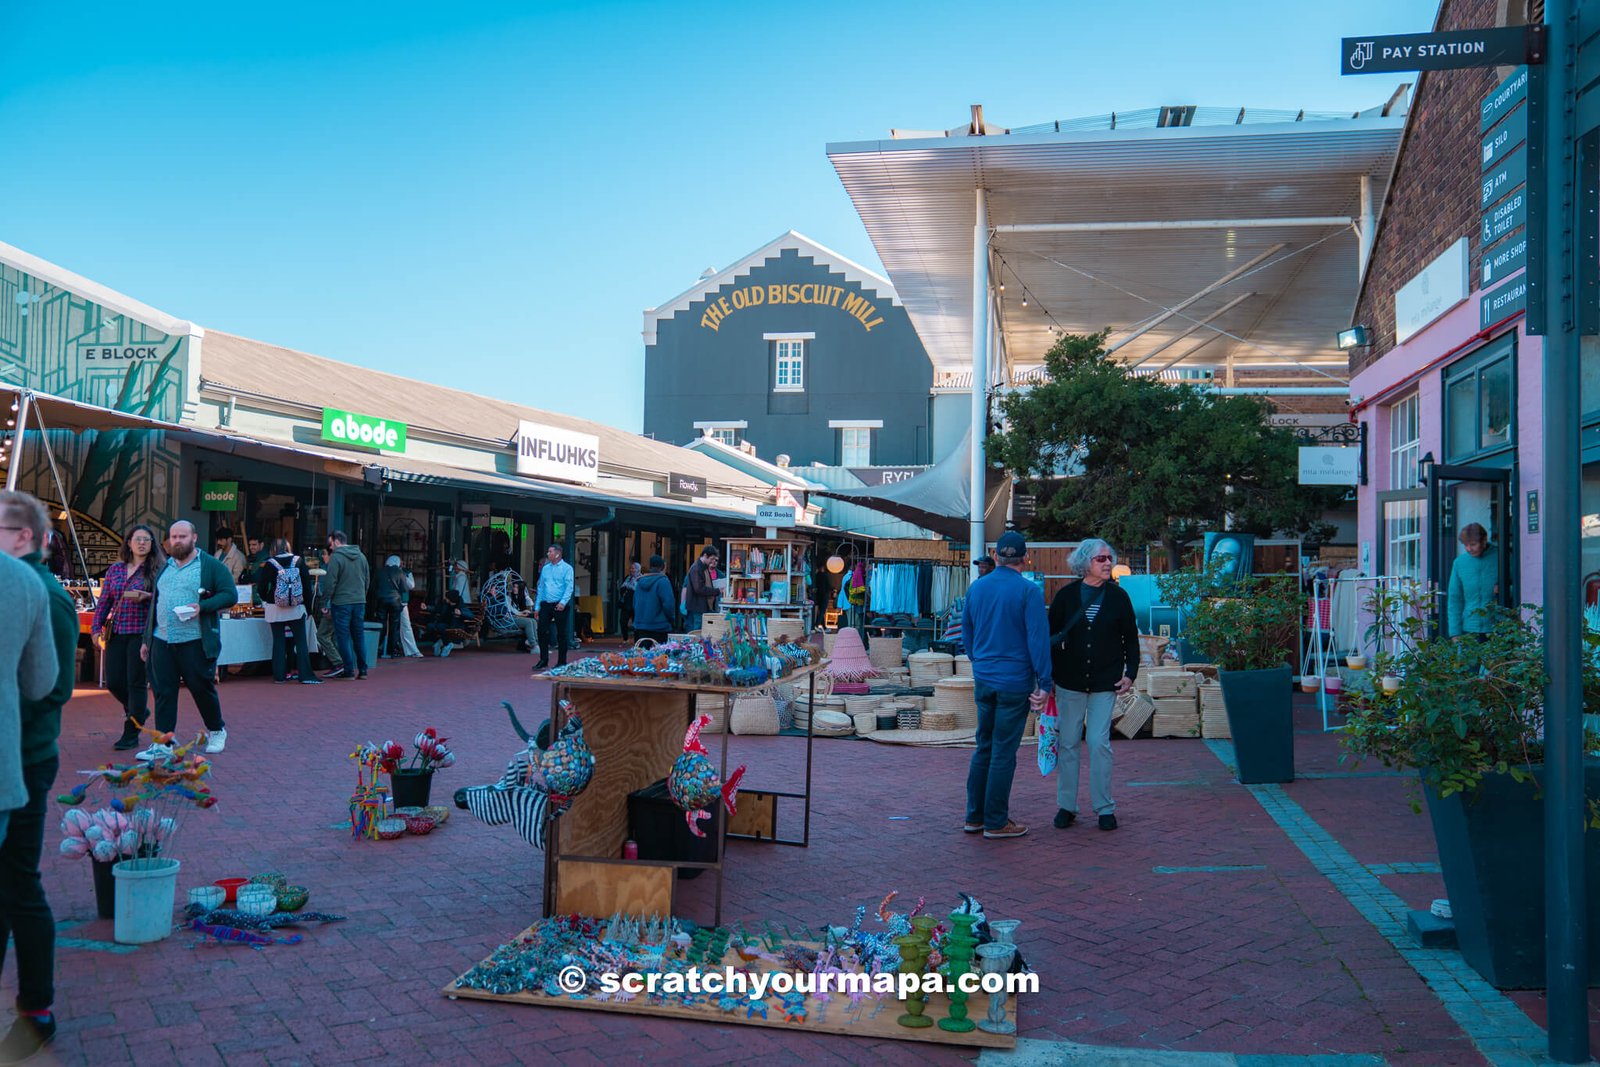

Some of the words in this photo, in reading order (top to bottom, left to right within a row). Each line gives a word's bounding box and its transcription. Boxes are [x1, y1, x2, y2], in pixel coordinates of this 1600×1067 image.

[1382, 46, 1413, 60] PAY
[1417, 41, 1485, 58] STATION
[1494, 130, 1508, 149] SILO
[1494, 171, 1507, 188] ATM
[1494, 195, 1522, 222] DISABLED
[1493, 215, 1514, 237] TOILET
[1493, 250, 1510, 269] MORE
[700, 296, 734, 332] THE
[731, 285, 765, 310] OLD
[768, 283, 845, 307] BISCUIT
[841, 291, 885, 332] MILL
[85, 348, 96, 360] E
[101, 347, 157, 360] BLOCK
[331, 413, 398, 448] abode
[520, 435, 597, 469] INFLUHKS
[204, 491, 235, 501] abode
[759, 510, 773, 518] OBZ
